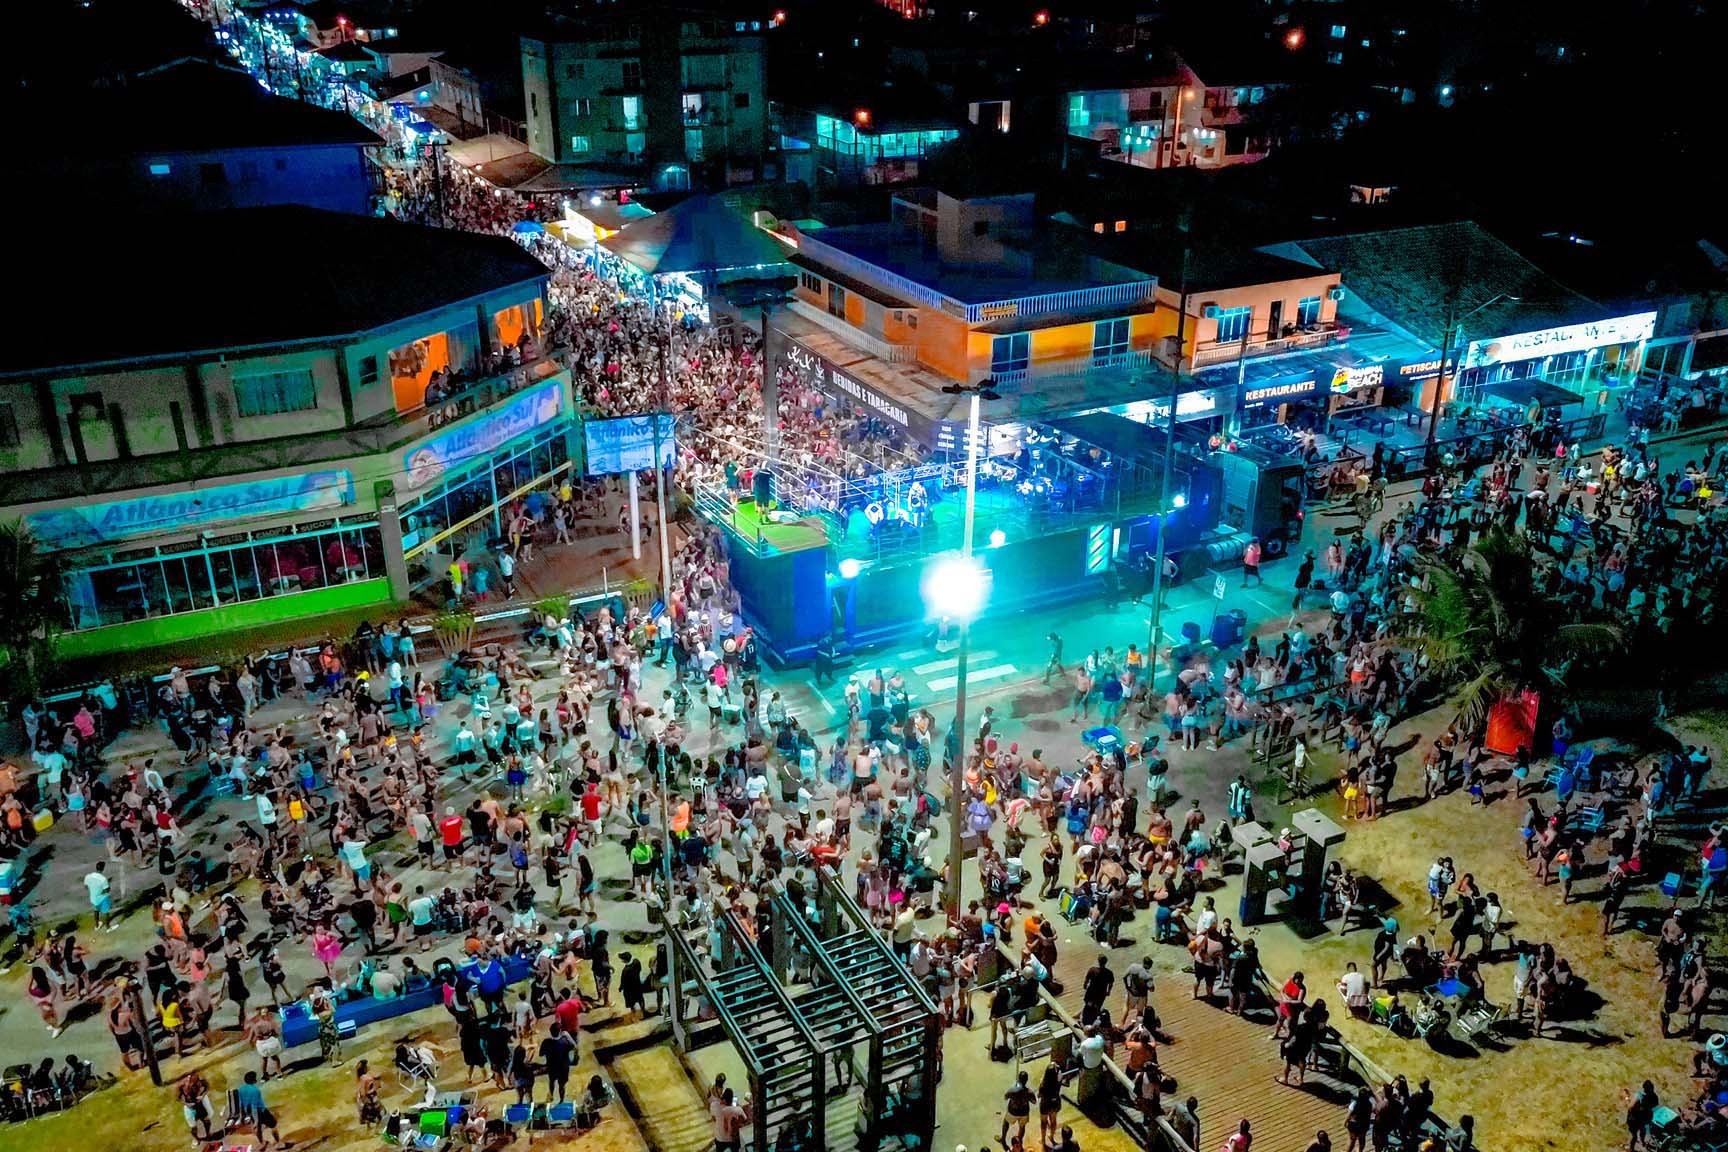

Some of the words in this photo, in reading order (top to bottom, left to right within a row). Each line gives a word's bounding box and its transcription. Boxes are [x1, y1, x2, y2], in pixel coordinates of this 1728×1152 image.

[1400, 358, 1452, 375] PETISCARA
[1348, 373, 1383, 387] BEACH
[1245, 380, 1316, 401] RESTAURANTE
[247, 479, 289, 505] Sul
